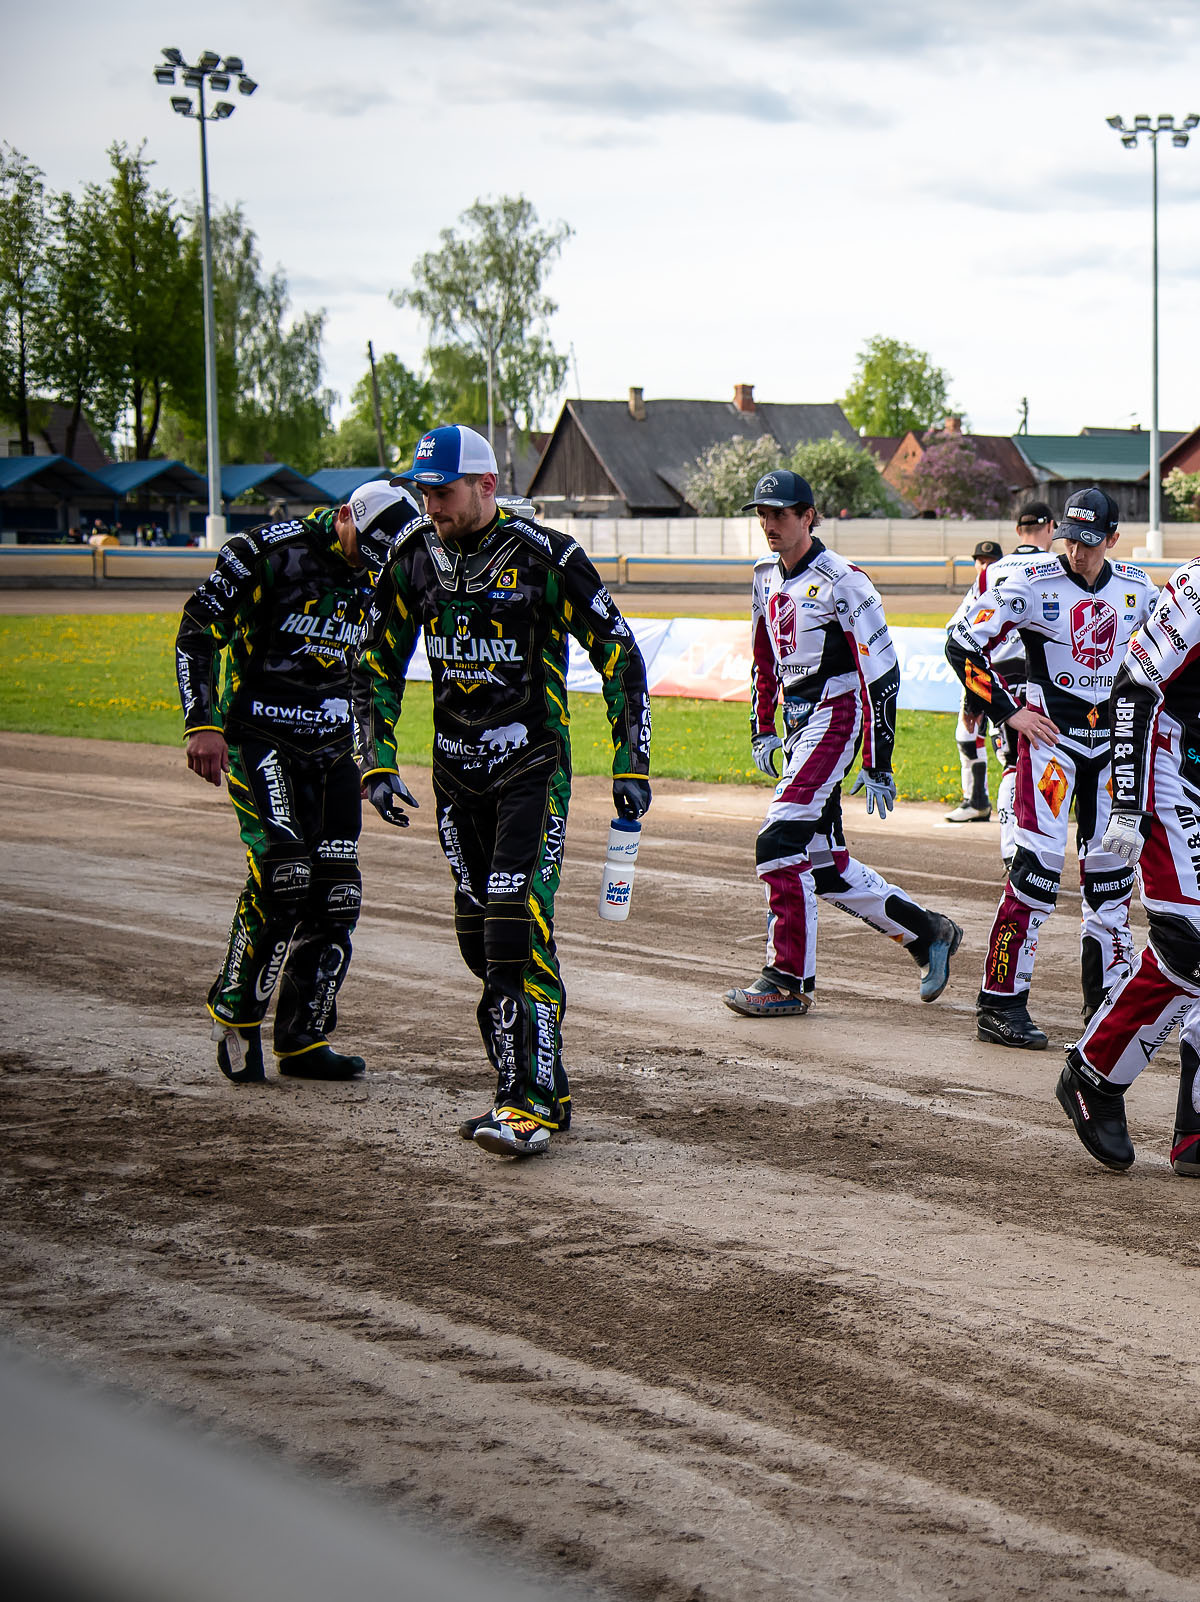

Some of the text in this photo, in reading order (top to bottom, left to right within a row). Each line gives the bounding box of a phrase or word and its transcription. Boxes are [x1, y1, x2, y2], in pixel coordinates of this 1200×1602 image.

[852, 595, 877, 618] OPTIBET
[280, 613, 359, 646] KOLEJAR
[441, 666, 508, 687] METALIKA
[1078, 675, 1117, 688] OPTIB
[252, 700, 323, 723] Rawicz
[1068, 727, 1088, 738] AMBER
[437, 732, 487, 756] Rawicz
[1113, 697, 1136, 801] JBM & VBJ
[256, 750, 304, 841] METALIKA
[488, 872, 527, 888] CDC
[607, 881, 631, 895] Smak
[1025, 872, 1051, 891] AMBER
[1093, 879, 1120, 893] AMBER
[605, 893, 629, 903] MAK
[263, 940, 287, 991] WIKO
[535, 1001, 552, 1050] GROUP
